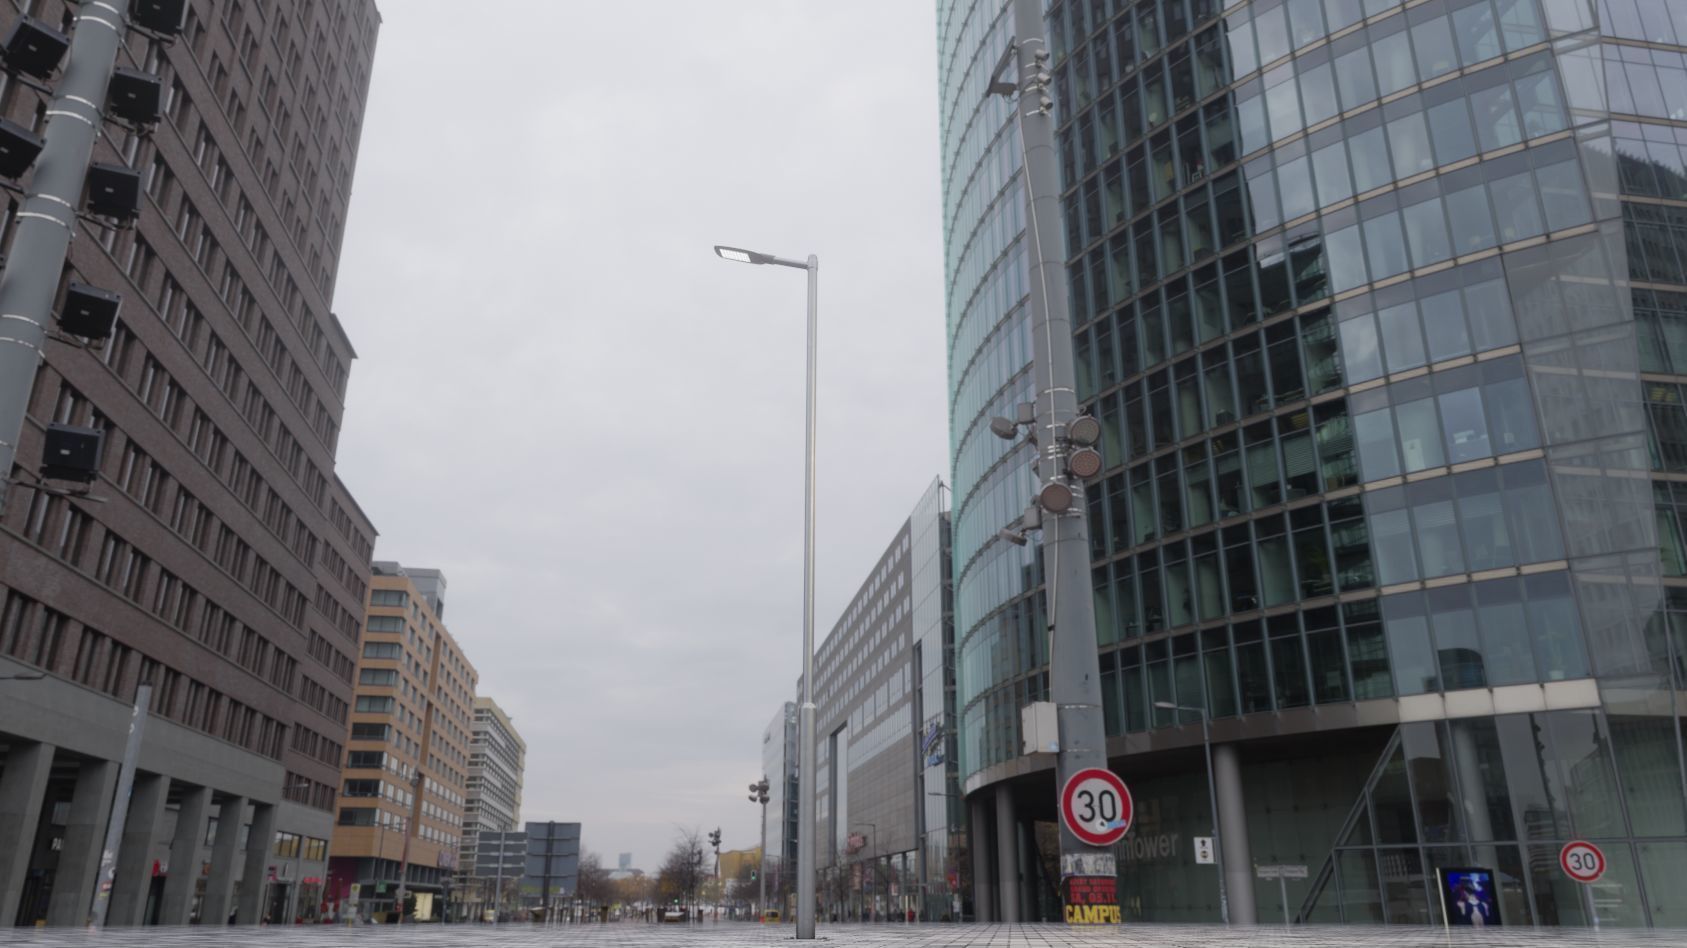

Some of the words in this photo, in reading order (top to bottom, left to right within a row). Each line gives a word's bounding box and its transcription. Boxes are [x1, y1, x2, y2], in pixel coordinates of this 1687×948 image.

[1077, 789, 1117, 823] 30
[1569, 852, 1596, 871] 30
[1065, 904, 1121, 923] CAMPUS
